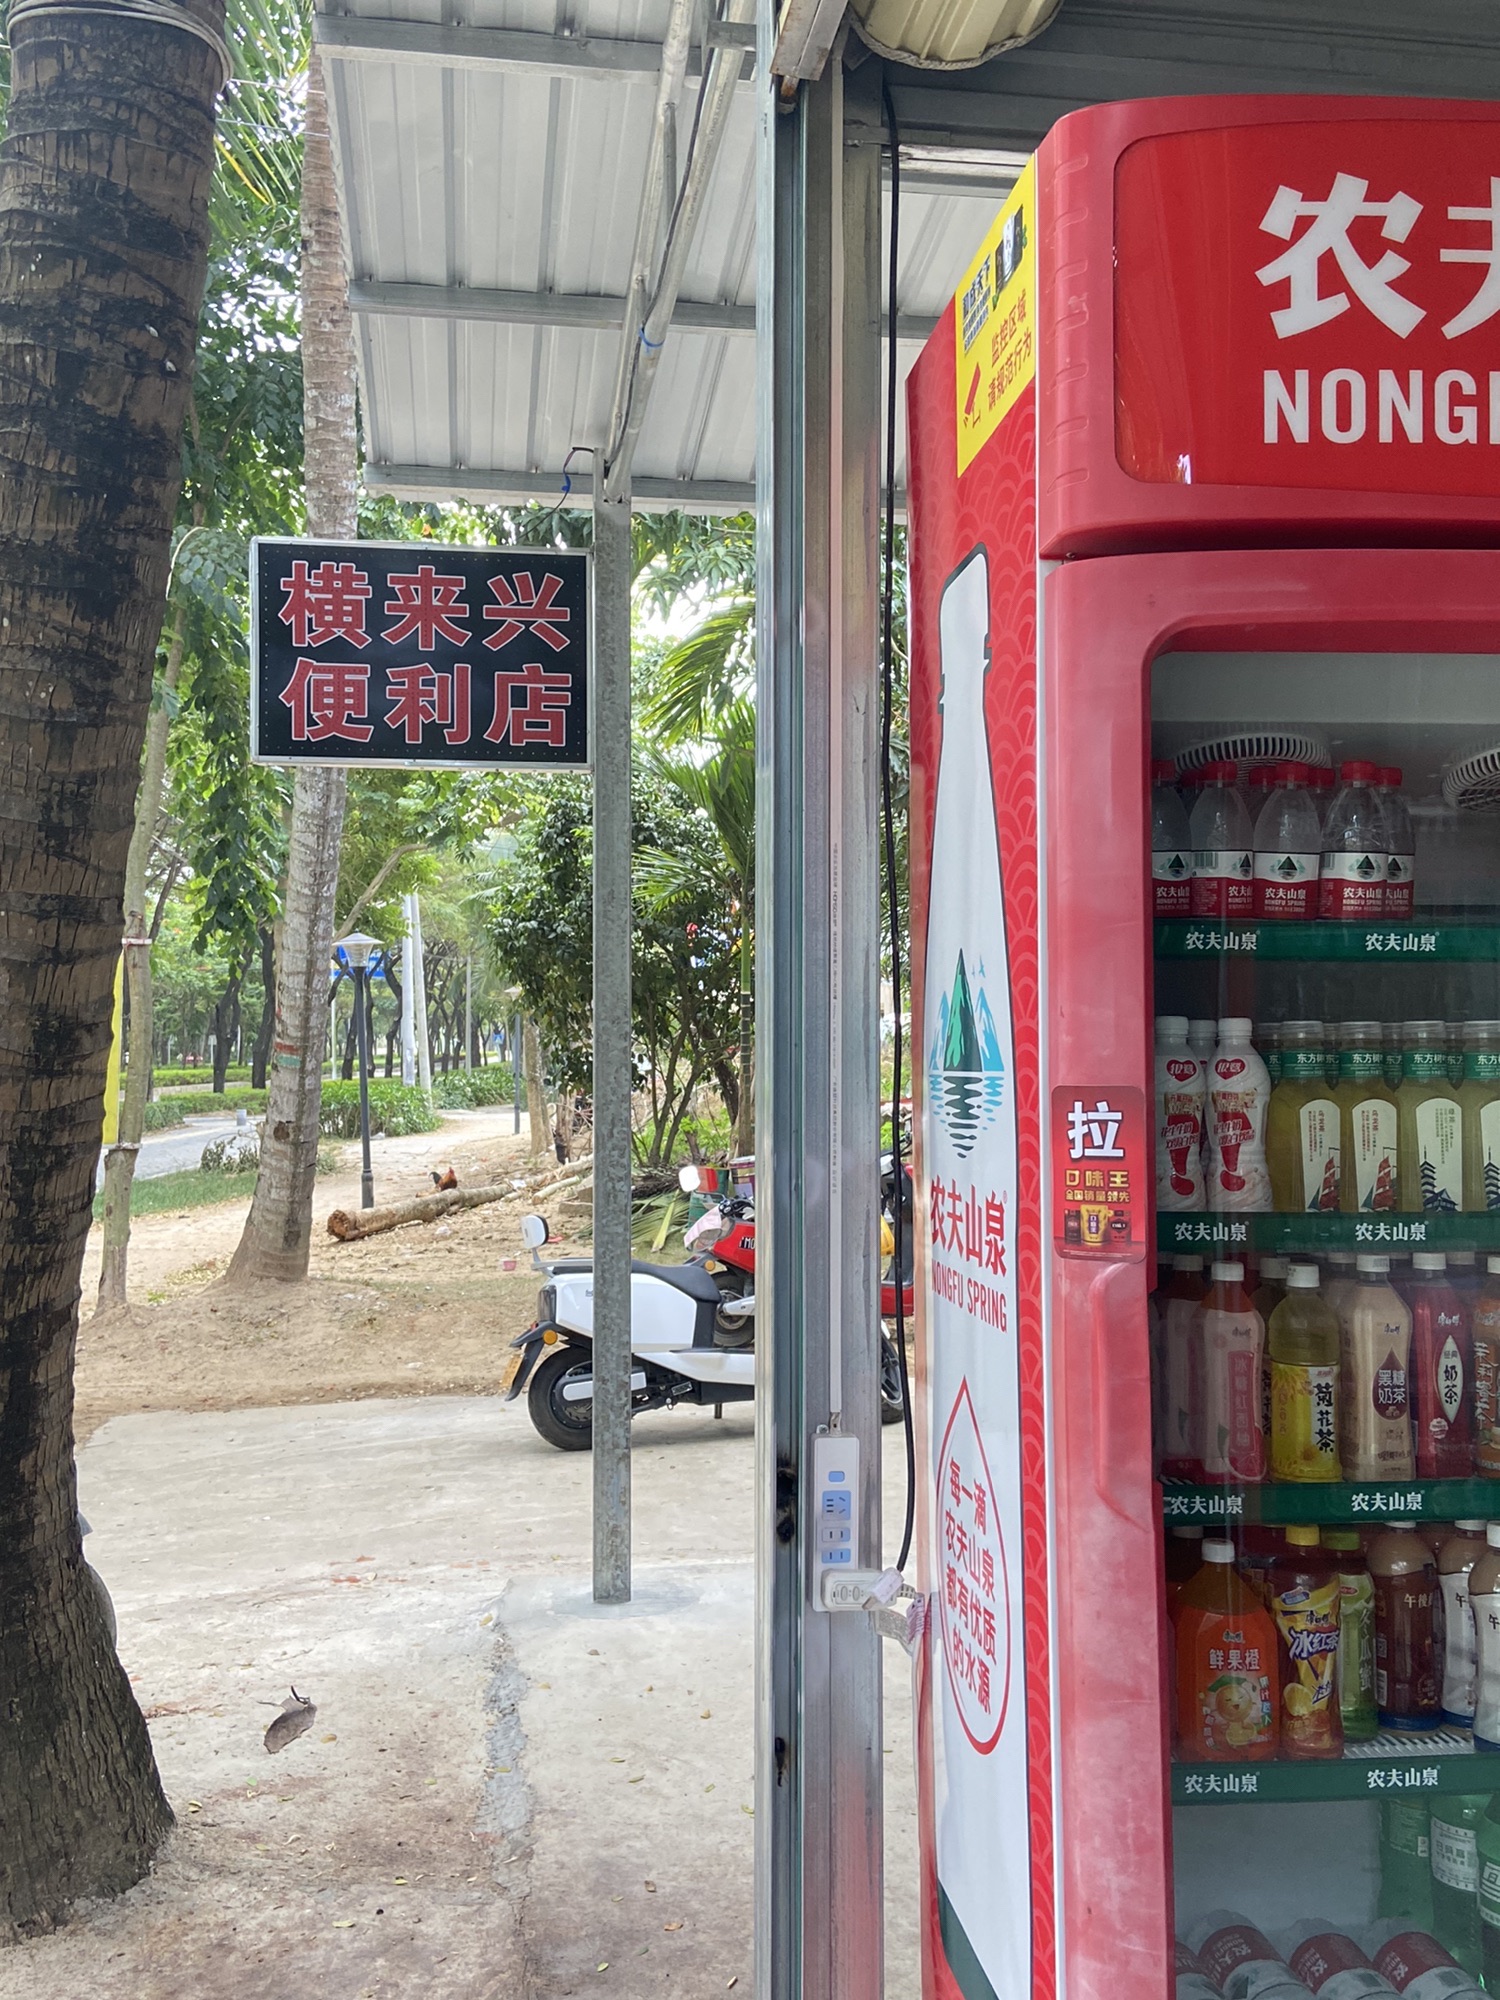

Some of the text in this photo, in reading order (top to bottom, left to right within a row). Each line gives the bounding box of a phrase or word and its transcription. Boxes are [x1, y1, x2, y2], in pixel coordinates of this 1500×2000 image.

[992, 288, 1026, 368] 监控区域
[988, 327, 1032, 411] 请规范行为
[1263, 367, 1500, 445] NONG
[278, 560, 571, 652] 横来兴
[278, 657, 572, 747] 便利店
[1264, 887, 1307, 900] 农夫山泉
[1342, 887, 1382, 899] 农夫山泉
[1185, 931, 1258, 951] 农夫山泉
[1364, 932, 1437, 952] 农夫山泉
[1067, 1101, 1125, 1160] 拉
[1065, 1169, 1130, 1188] 口味王
[1065, 1189, 1130, 1203] 全国销量领先
[931, 1175, 1007, 1277] 农夫山泉
[1174, 1221, 1248, 1242] 农夫山泉
[1354, 1221, 1427, 1242] 农夫山泉
[932, 1258, 1007, 1333] NONGFU SPRING
[1378, 1369, 1406, 1386] 黑糖
[1443, 1364, 1459, 1405] 奶茶
[1378, 1388, 1406, 1405] 奶茶
[1313, 1382, 1335, 1453] 菊花茶
[950, 1456, 987, 1535] 每一滴
[1170, 1494, 1243, 1515] 农夫山泉
[1351, 1491, 1423, 1512] 农夫山泉
[945, 1508, 996, 1603] 农夫山泉
[946, 1560, 997, 1666] 都有优质
[1289, 1626, 1340, 1660] 冰红茶
[952, 1623, 991, 1716] 的水源
[1209, 1648, 1260, 1671] 鲜果橙
[1184, 1773, 1258, 1794] 农夫山泉
[1366, 1767, 1439, 1789] 农夫山泉
